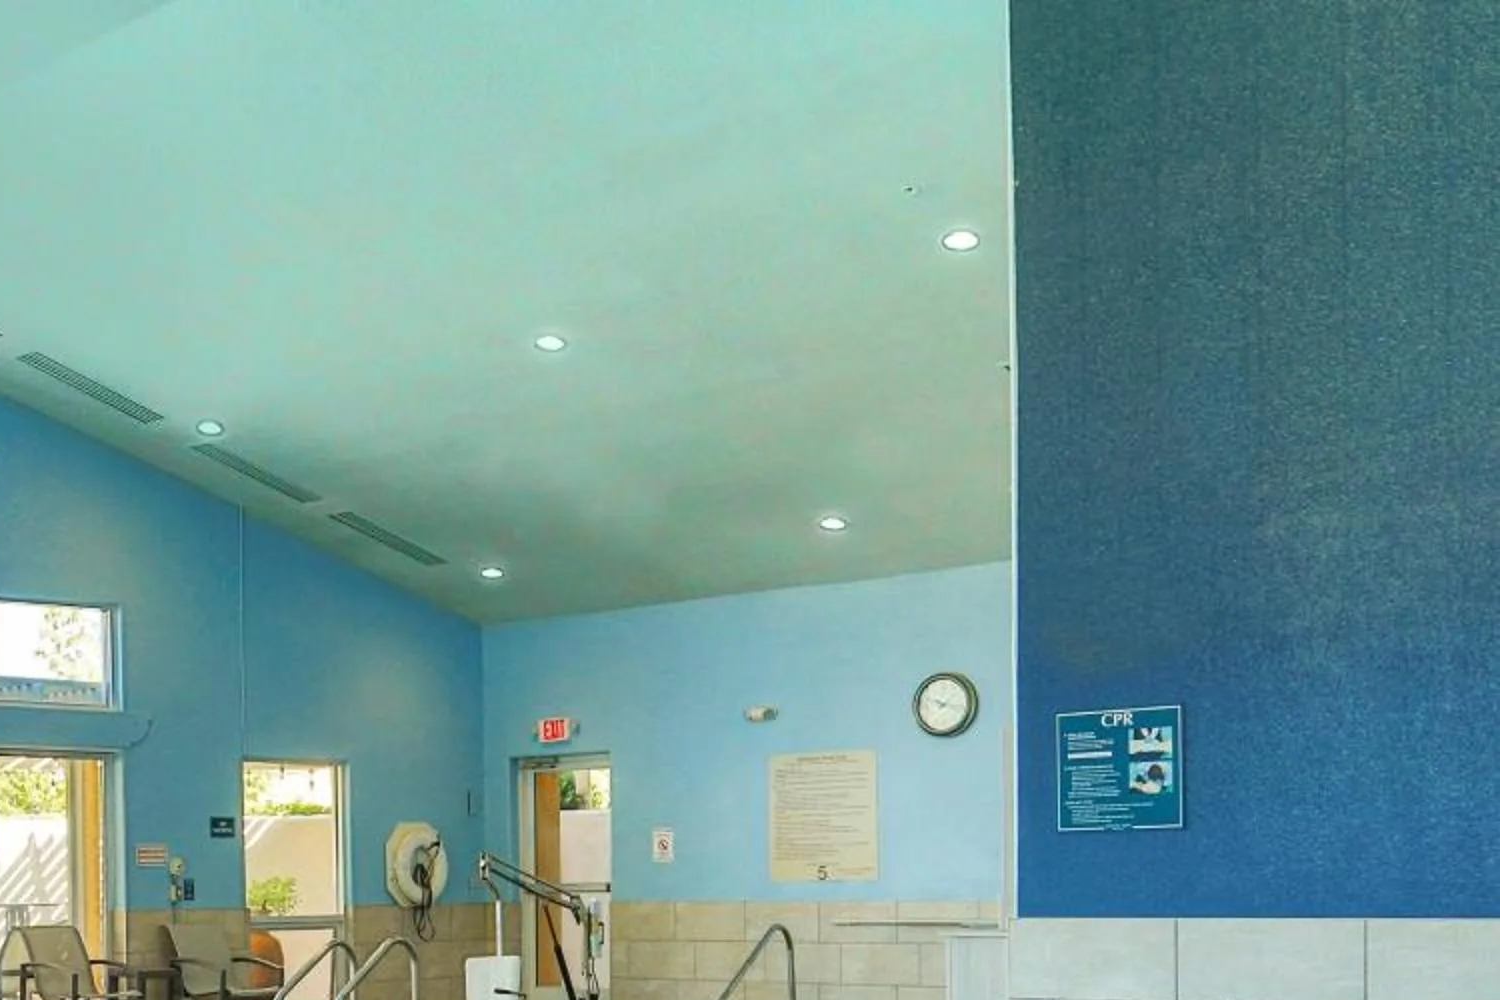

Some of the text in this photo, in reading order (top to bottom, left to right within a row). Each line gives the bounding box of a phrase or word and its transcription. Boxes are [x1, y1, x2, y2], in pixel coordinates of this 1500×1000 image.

[1101, 713, 1134, 727] CPR
[543, 719, 565, 740] EXIT
[817, 865, 828, 881] 5
